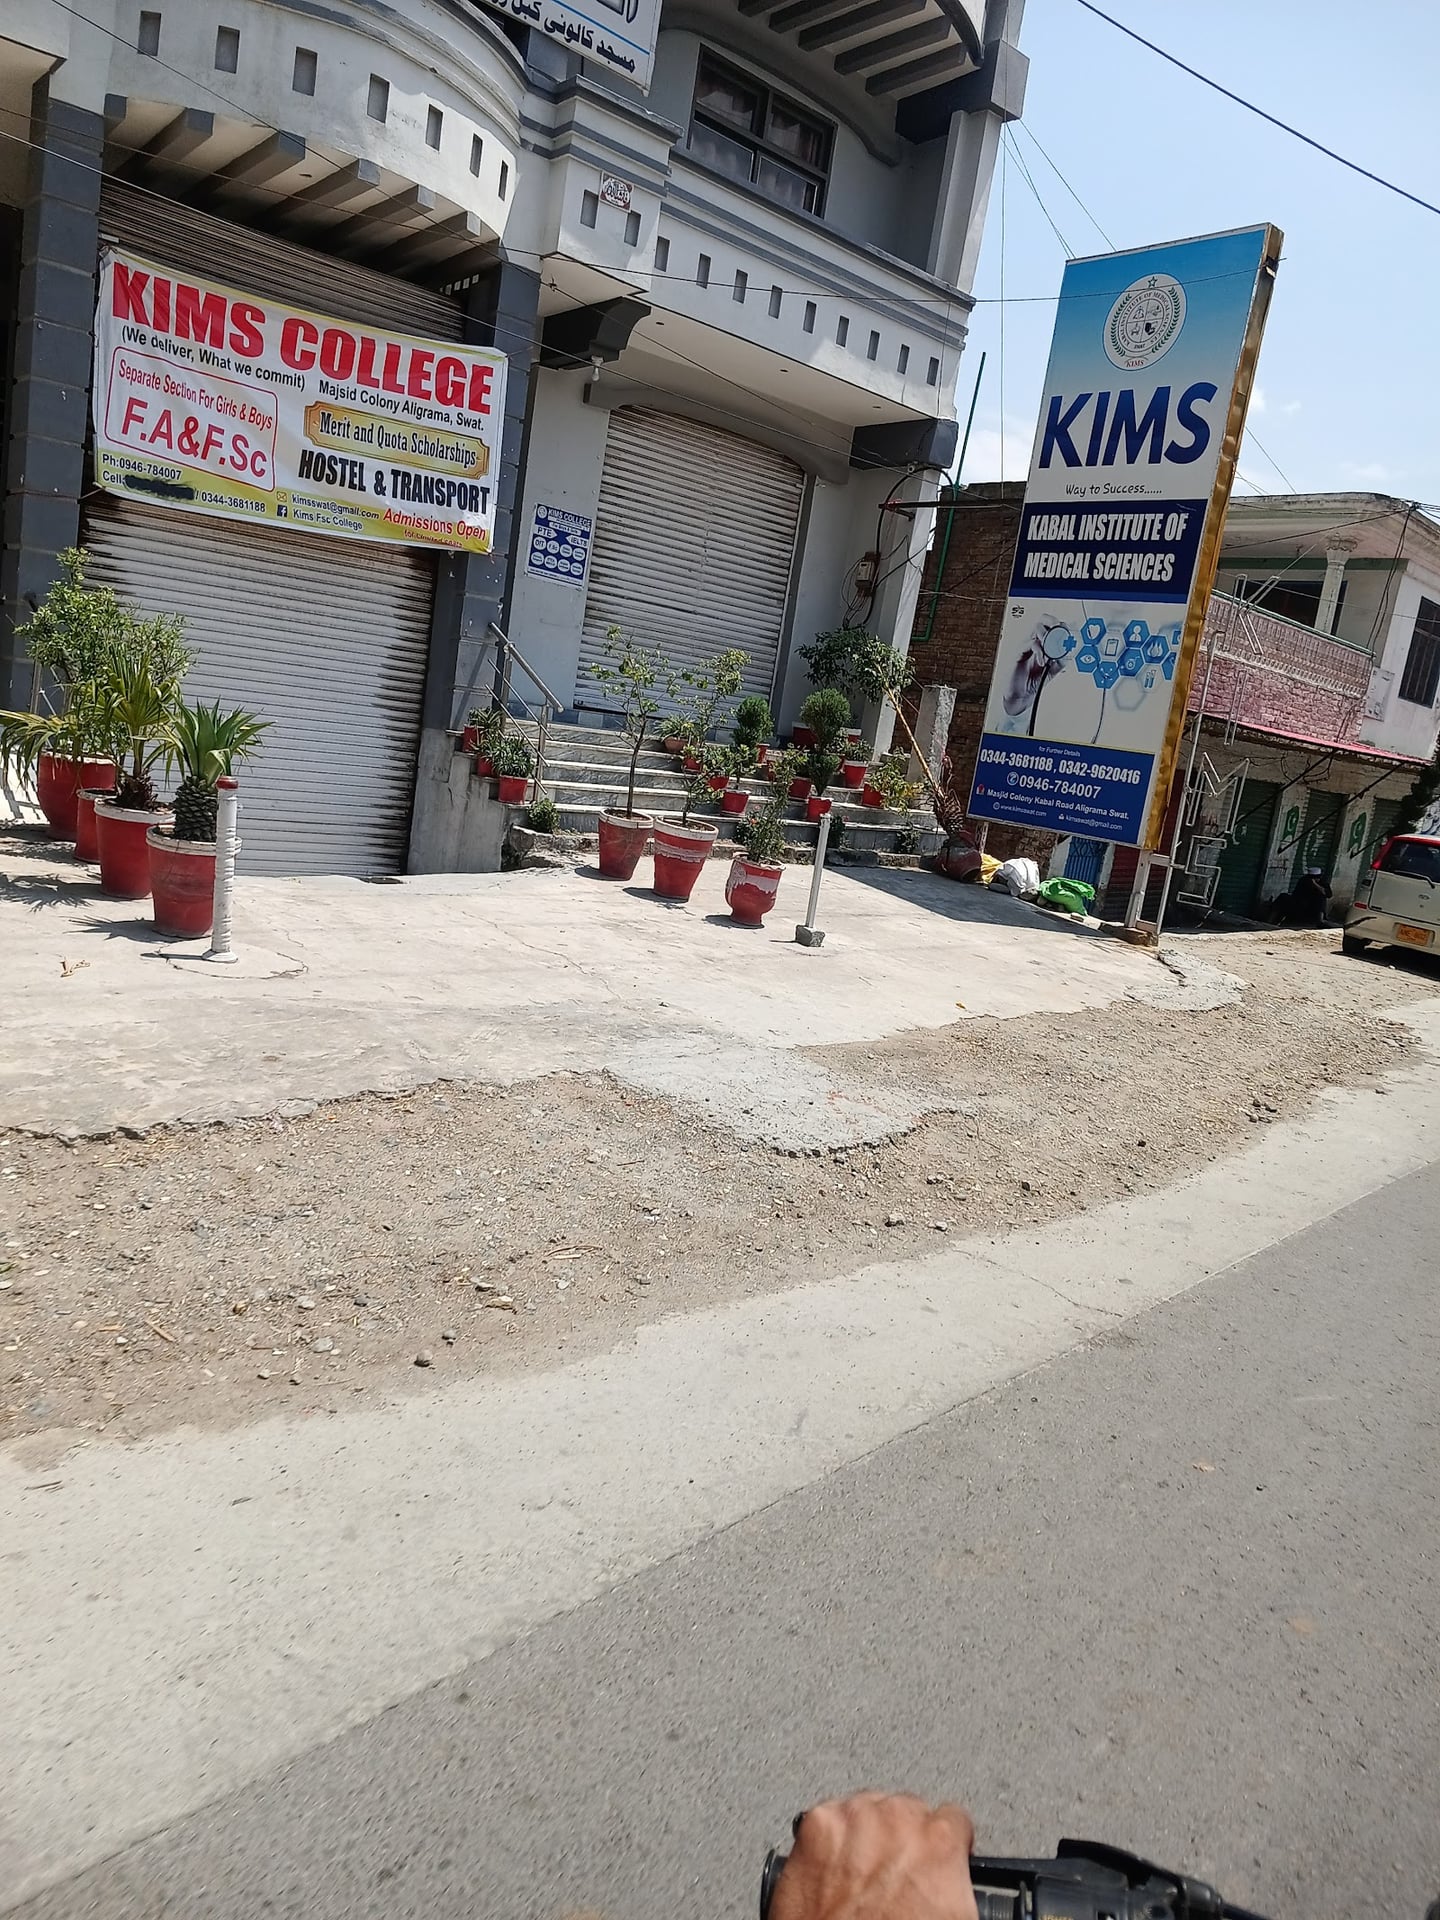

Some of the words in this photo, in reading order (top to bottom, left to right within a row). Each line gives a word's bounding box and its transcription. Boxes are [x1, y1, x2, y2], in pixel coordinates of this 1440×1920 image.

[596, 40, 635, 73] مسجد
[113, 261, 266, 358] KIMS
[281, 318, 494, 415] COLLEGE
[122, 325, 147, 346] (We
[151, 335, 195, 363] deliver,
[199, 349, 232, 371] What
[235, 361, 252, 375] we
[255, 367, 306, 391] commit)
[1126, 360, 1144, 368] KIMS
[119, 359, 161, 389] Separate
[163, 374, 197, 403] Section
[199, 389, 215, 409] For
[216, 395, 237, 417] Girls
[239, 403, 247, 420] &
[248, 406, 273, 431] Boys
[319, 379, 357, 401] Majsid
[360, 390, 400, 414] Colony
[401, 401, 453, 426] Aligrama,
[456, 412, 485, 431] Swat.
[121, 396, 267, 478] F.A&F.Sc
[320, 411, 351, 439] Merit
[353, 421, 374, 444] and
[377, 425, 408, 451] Quota
[411, 432, 477, 470] Scholarships
[1038, 382, 1218, 469] KIMS
[102, 454, 182, 481] Ph:0946-784007
[298, 449, 366, 492] HOSTEL
[374, 470, 386, 496] &
[391, 468, 490, 515] TRANSPORT
[201, 492, 266, 513] 0344-3681188
[1066, 484, 1086, 497] Way
[1089, 485, 1100, 495] to
[293, 508, 314, 522] Kims
[316, 513, 331, 524] Fsc
[332, 516, 363, 531] College
[383, 508, 453, 536] Admissions
[457, 520, 487, 541] Open
[537, 527, 552, 538] PTE
[548, 509, 563, 519] KIMS
[563, 514, 591, 526] COLLEGE
[1027, 514, 1077, 541] KABAL
[1078, 513, 1164, 541] INSTITUTE
[1164, 513, 1189, 541] OF
[570, 536, 588, 547] IELTS
[1023, 552, 1091, 579] MEDICAL
[1093, 552, 1175, 582] SCIENCES
[980, 749, 1053, 771] 0344-3681188
[1058, 759, 1141, 785] 0342-9620416
[1019, 775, 1102, 799] 0946-784007
[986, 788, 1009, 800] Masjid
[1009, 793, 1033, 805] Colony
[1034, 796, 1055, 807] Kabal
[1055, 800, 1074, 810] Road
[1074, 803, 1108, 817] Aligrama
[1108, 809, 1130, 820] Swat.
